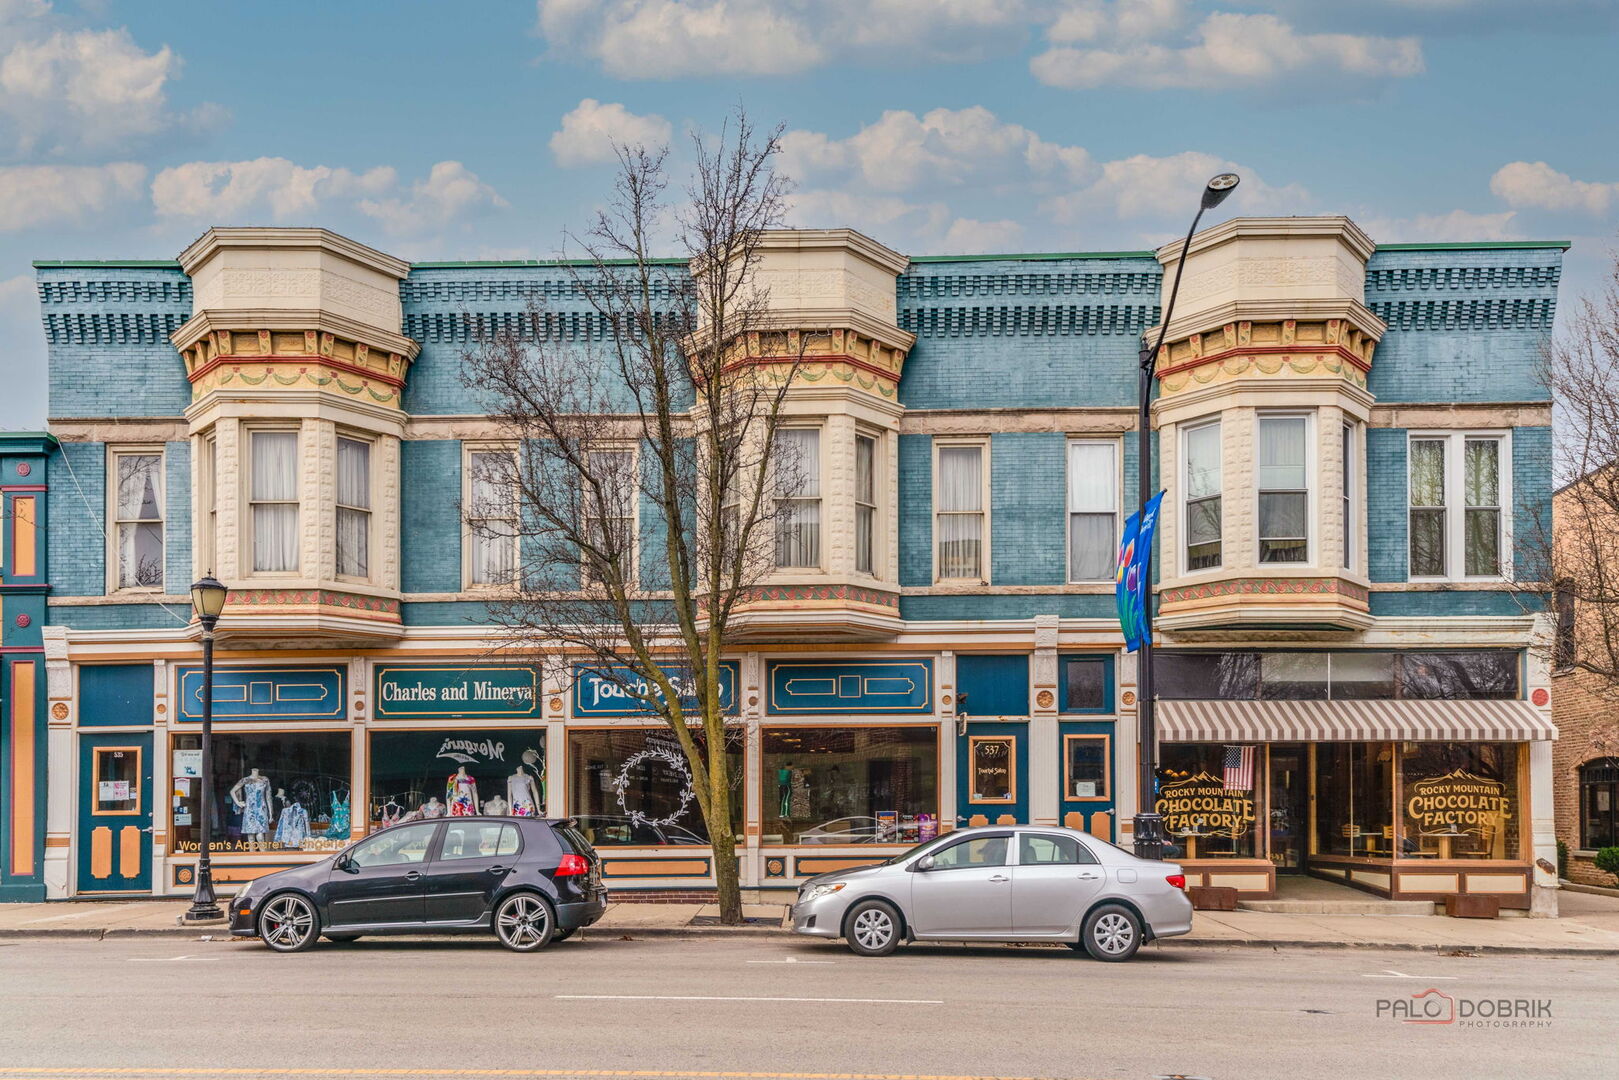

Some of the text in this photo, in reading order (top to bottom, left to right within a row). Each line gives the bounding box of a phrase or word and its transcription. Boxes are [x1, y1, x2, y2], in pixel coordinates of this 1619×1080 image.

[382, 681, 533, 701] Charles and Minerva
[984, 745, 1000, 755] 537
[1165, 787, 1244, 799] ROCKY MOUNTAIN
[1420, 785, 1500, 796] ROCKY MOUNTAIN
[1155, 798, 1256, 821] CHOCOLATE
[1408, 795, 1512, 819] CHOCOLATE
[1169, 813, 1243, 829] FACTORY
[1424, 811, 1499, 826] FACTORY
[179, 840, 232, 851] Woen's
[235, 839, 283, 851] Apparel
